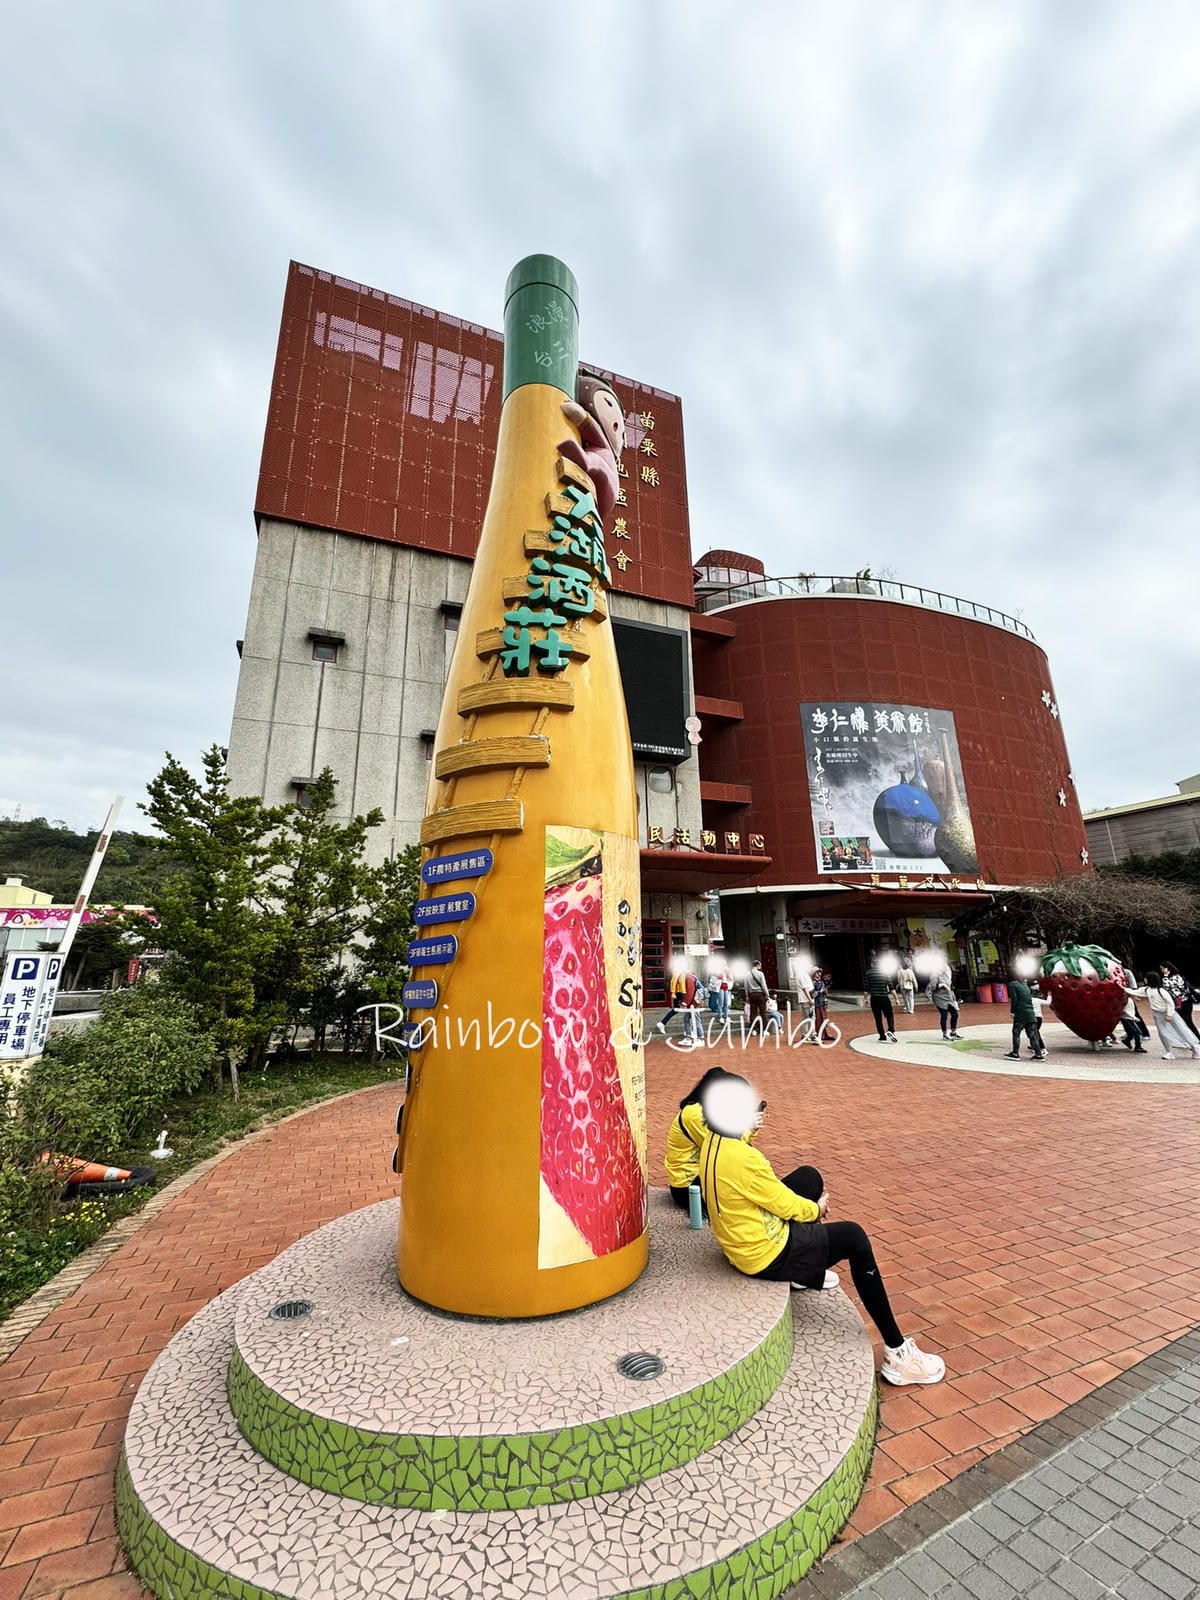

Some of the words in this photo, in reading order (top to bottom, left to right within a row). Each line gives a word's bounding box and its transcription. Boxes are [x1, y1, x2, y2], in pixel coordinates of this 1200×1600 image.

[640, 411, 660, 488] 苗栗縣
[16, 959, 36, 979] P
[49, 961, 60, 979] P
[0, 993, 16, 1045] 員工專用
[11, 986, 36, 1051] 地下停車場
